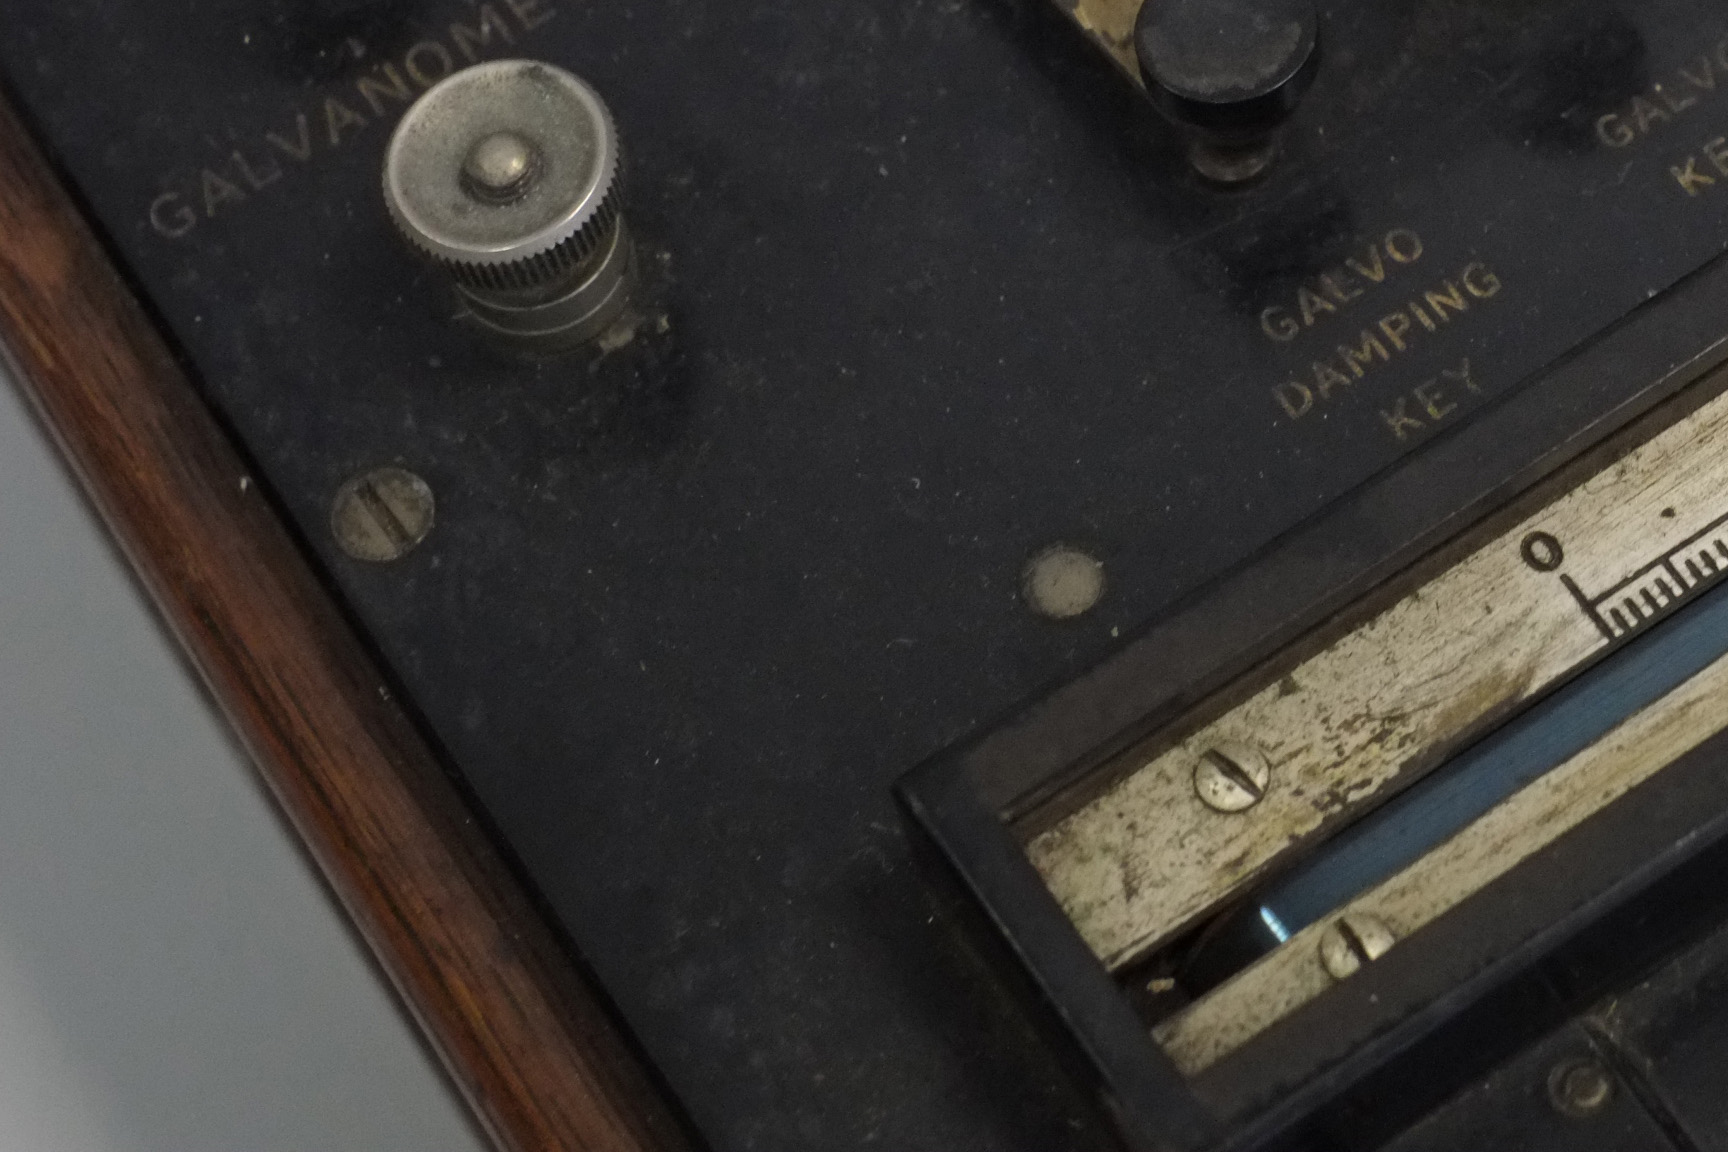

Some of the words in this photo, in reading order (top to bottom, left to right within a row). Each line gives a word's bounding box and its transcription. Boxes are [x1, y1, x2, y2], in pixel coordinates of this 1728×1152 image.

[1260, 228, 1424, 344] GALVO
[1272, 260, 1502, 420] DAMPING
[1380, 358, 1486, 440] KEY
[1521, 531, 1564, 574] 0
